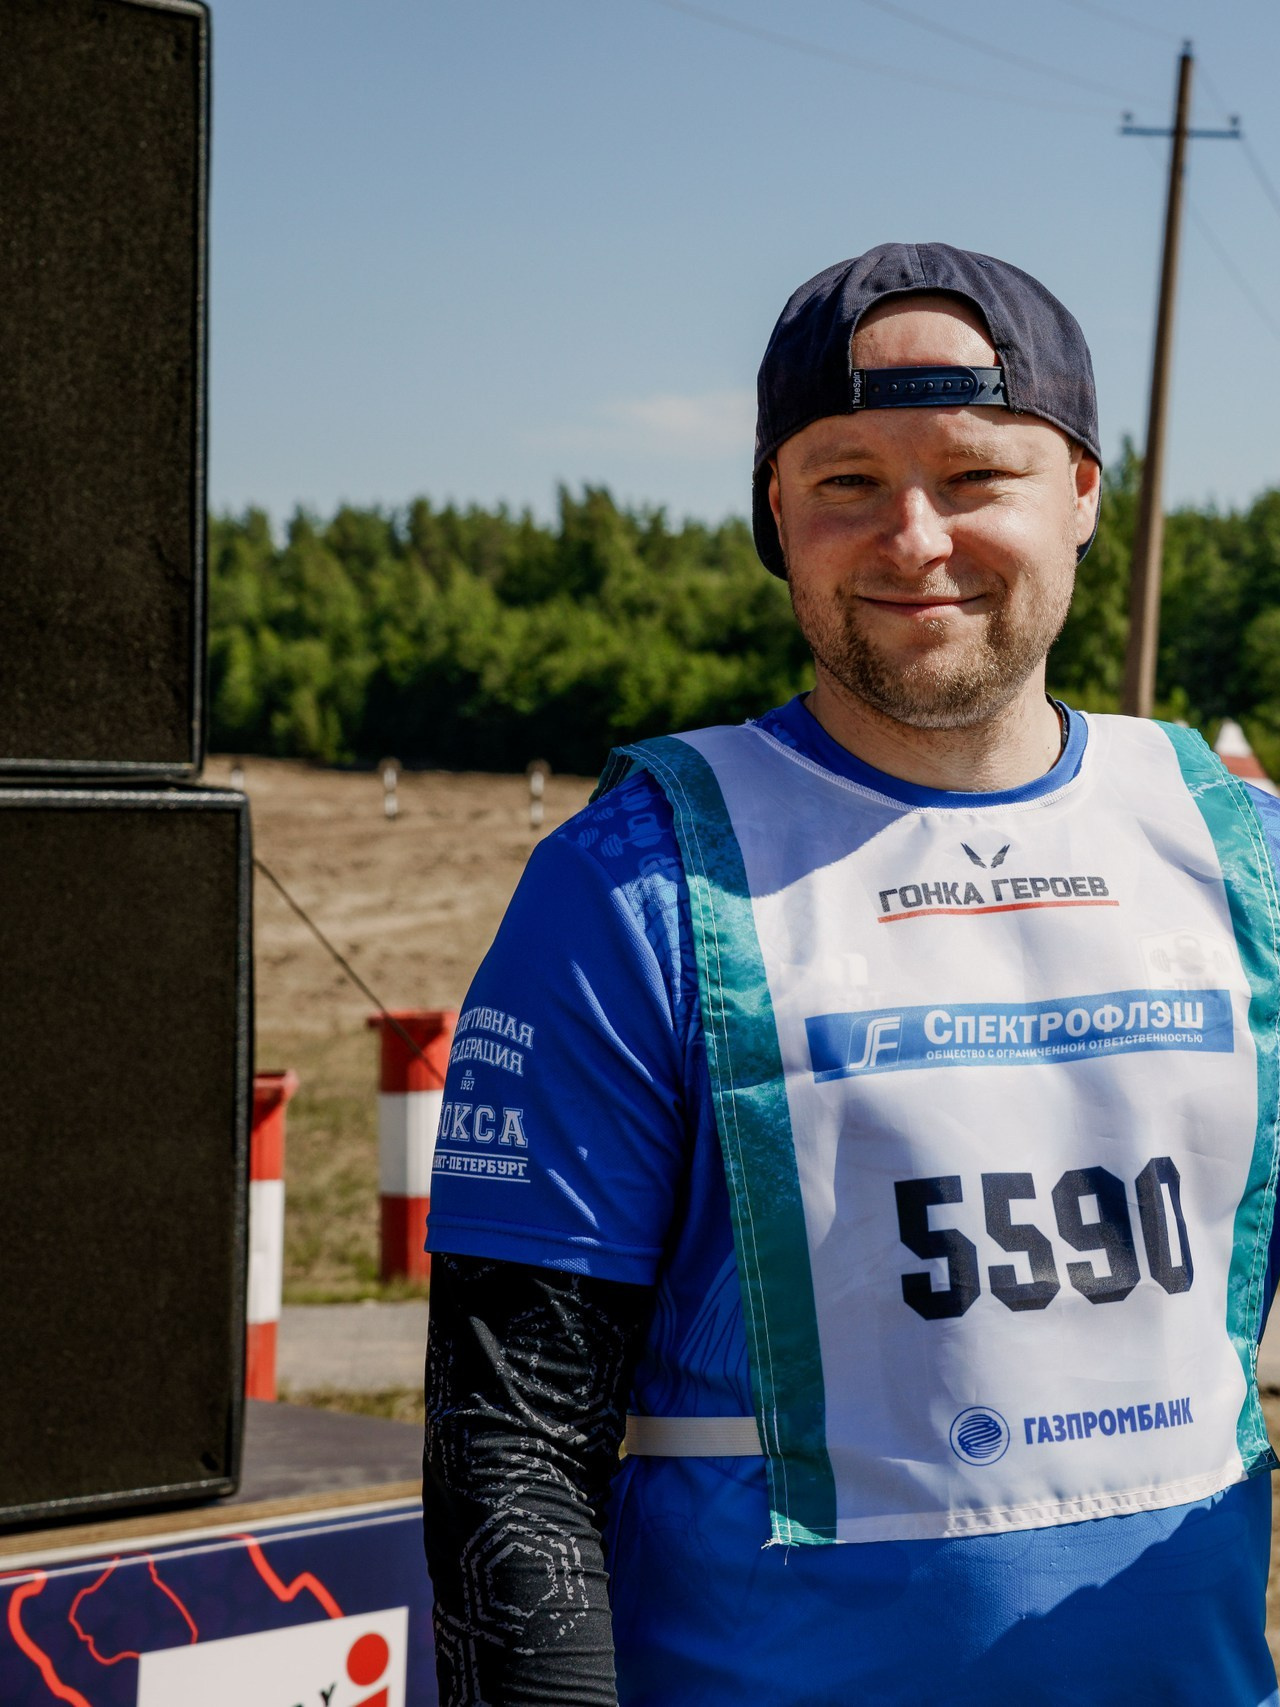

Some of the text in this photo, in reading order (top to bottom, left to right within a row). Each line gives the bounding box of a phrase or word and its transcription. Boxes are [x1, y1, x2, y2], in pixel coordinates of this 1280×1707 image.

[852, 371, 863, 405] TrueSpin
[878, 876, 1110, 913] ГОНКА ГЕРОЕВ
[454, 1006, 535, 1050] ПОРТИВНАЯ
[926, 1048, 986, 1061] ОБЩЕСТВО
[996, 1038, 1086, 1059] ОГРАНИЧЕННОЙ
[1088, 1033, 1203, 1050] ОТВЕТСТВЕННОСТЬЮ
[893, 1155, 1195, 1321] 5590
[1023, 1396, 1194, 1445] ГАЗПРОМБАНК
